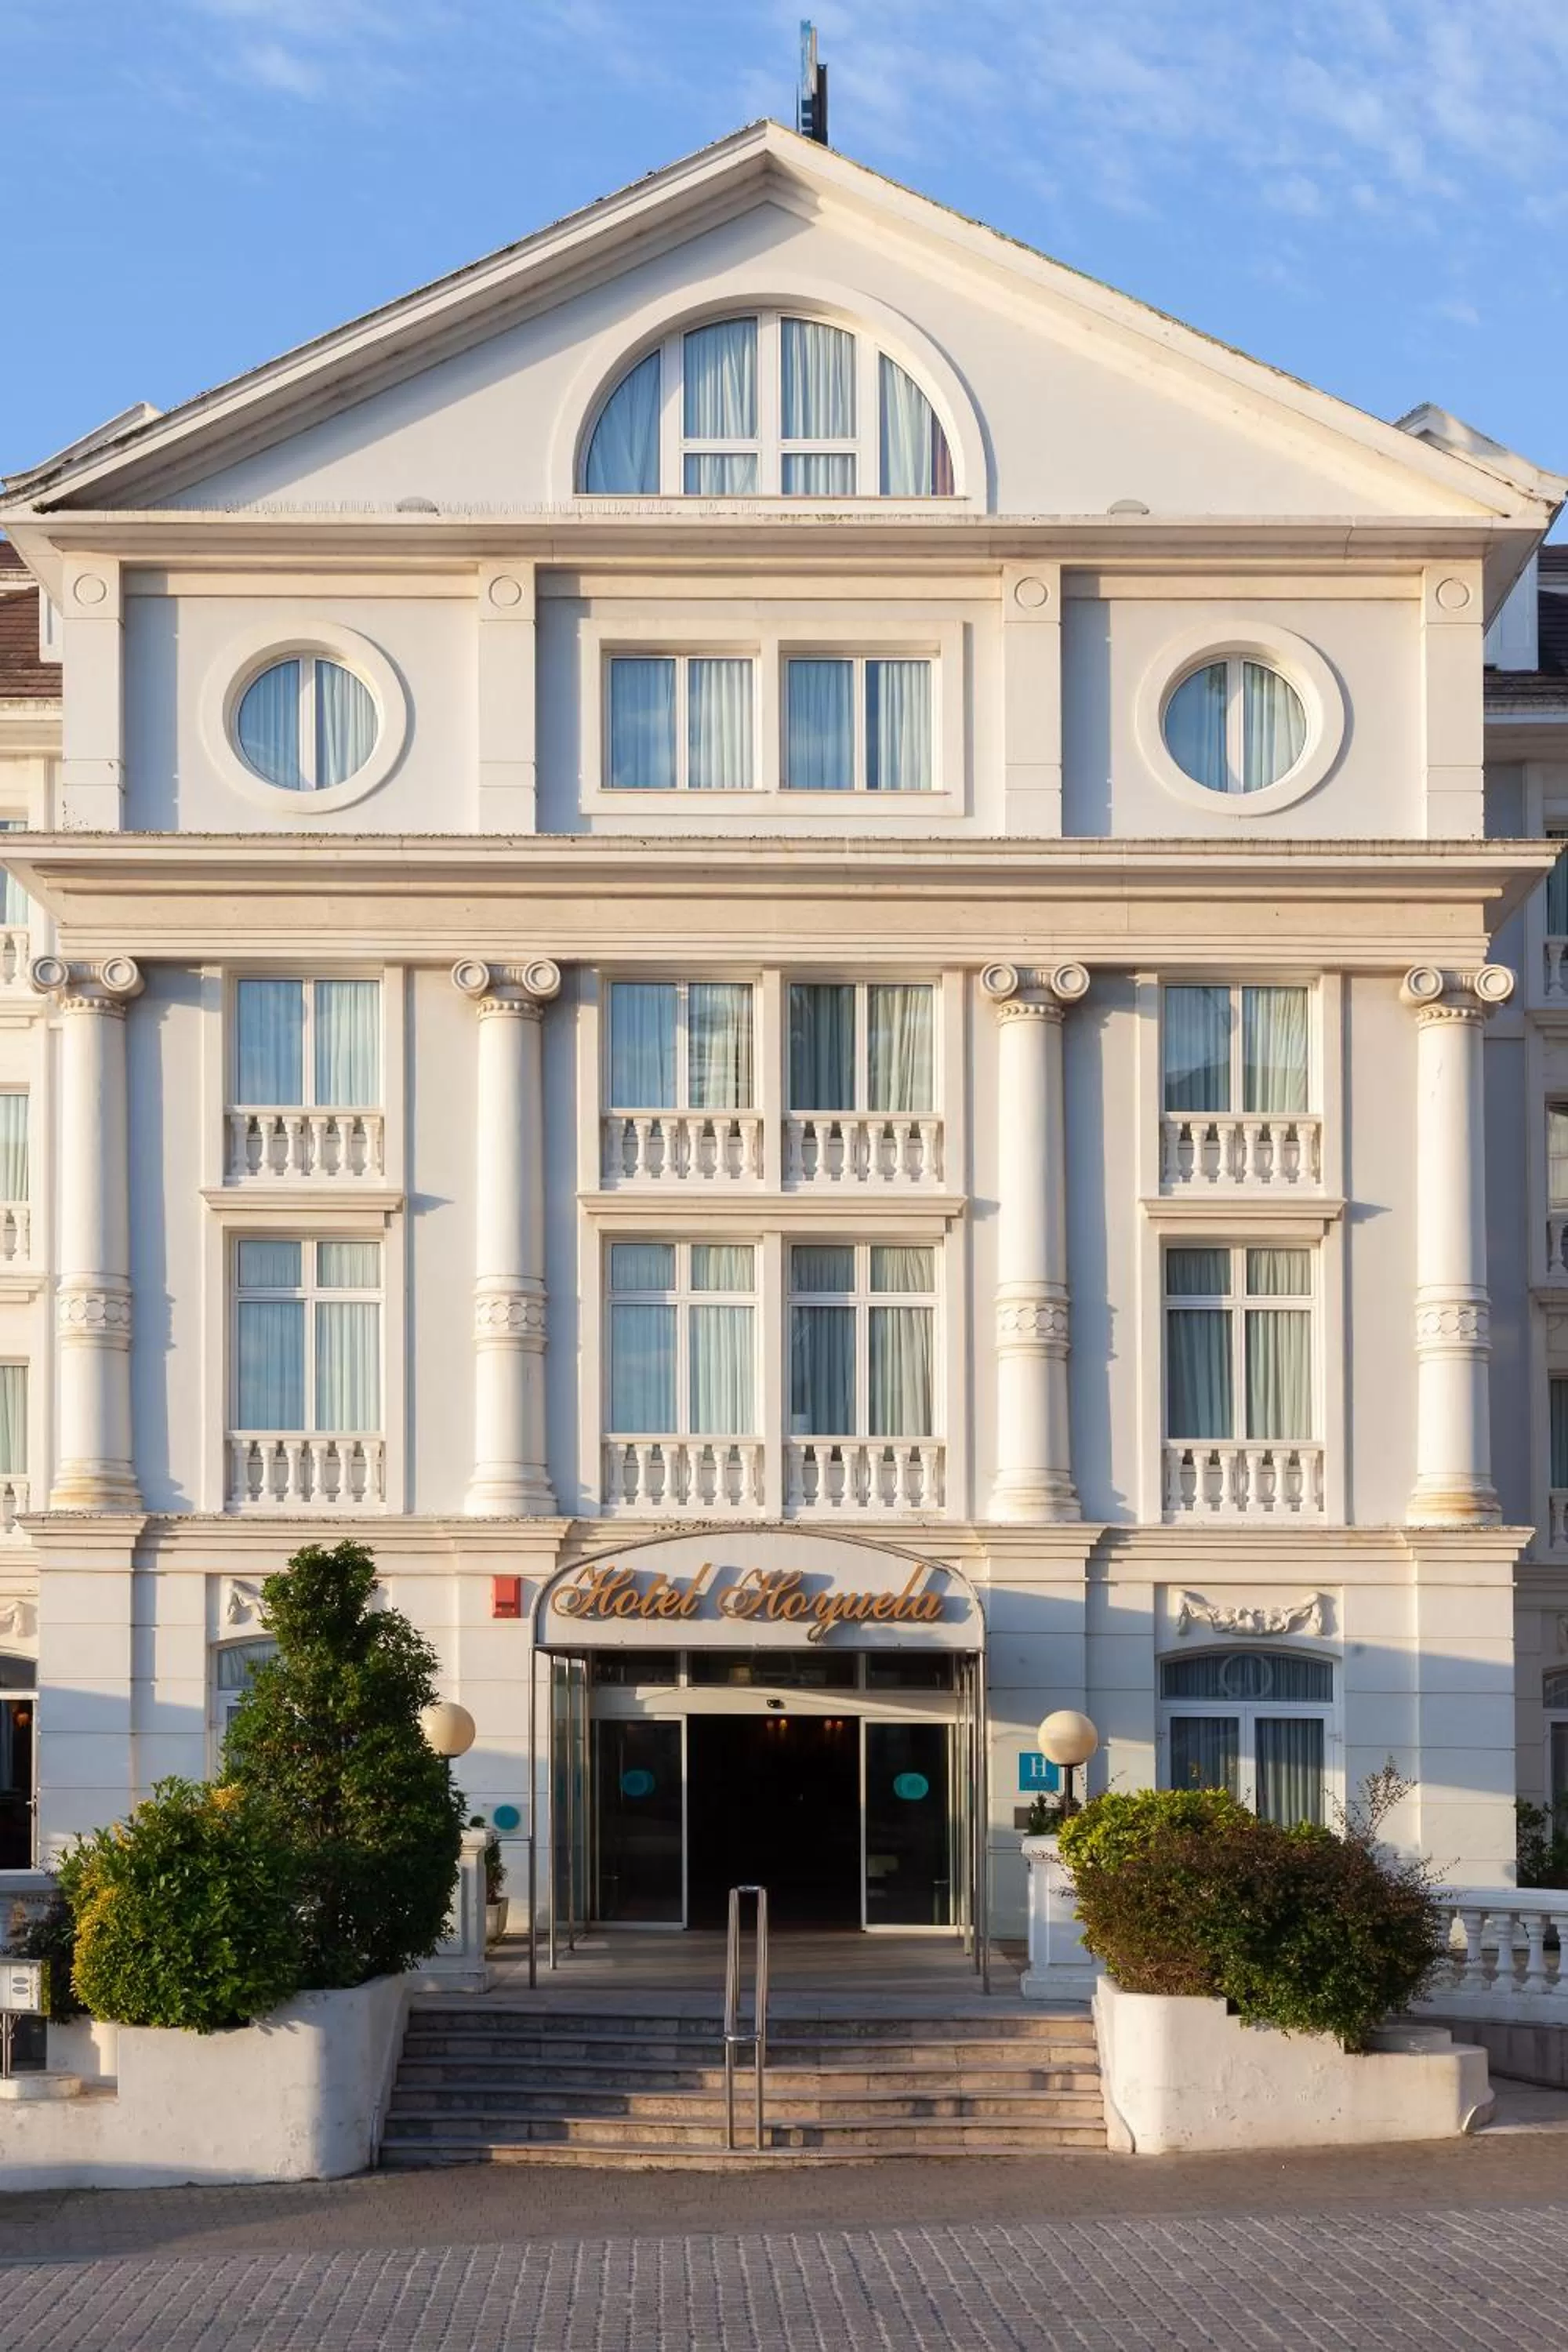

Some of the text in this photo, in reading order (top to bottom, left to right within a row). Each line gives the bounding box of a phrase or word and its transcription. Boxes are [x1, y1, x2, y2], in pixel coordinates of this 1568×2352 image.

[550, 1562, 944, 1642] Hotel Hoyuela
[1029, 1756, 1048, 1777] H
